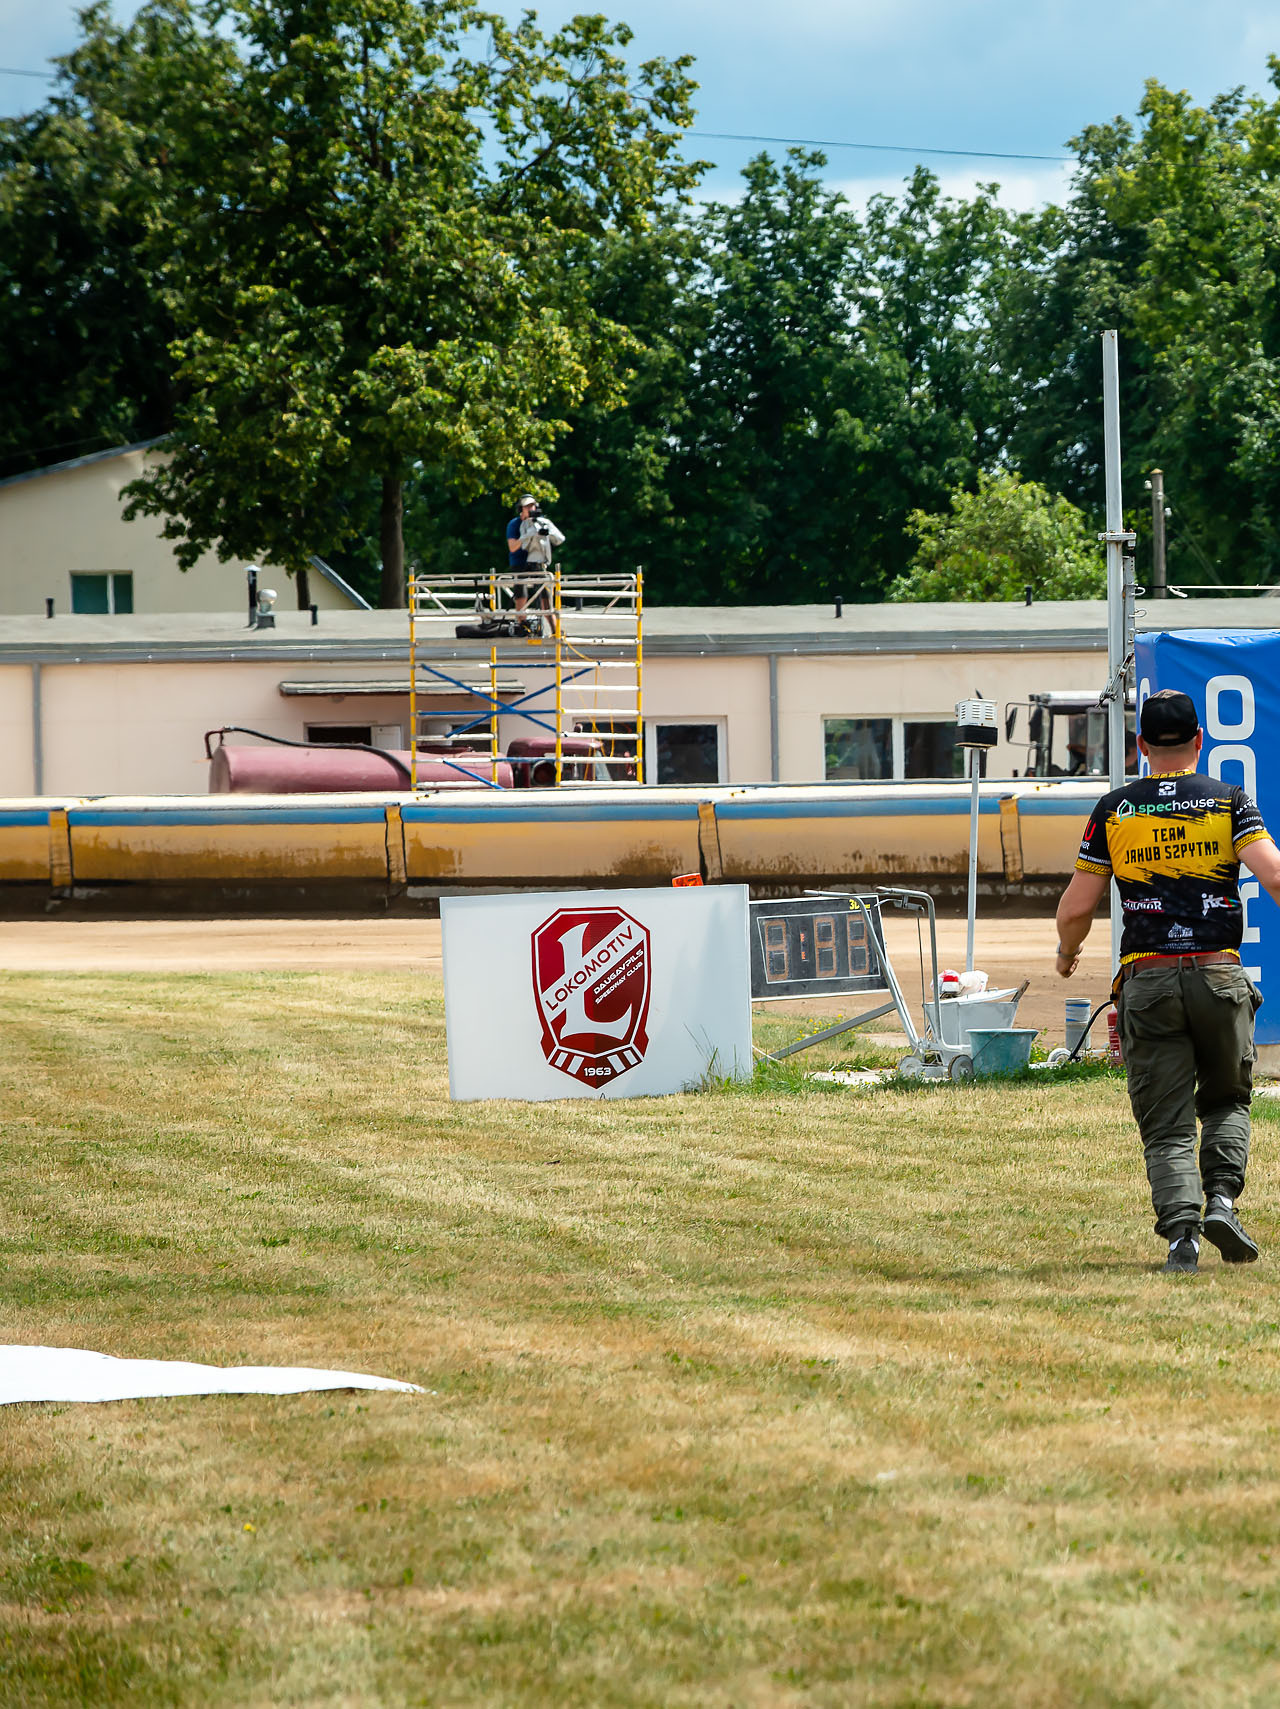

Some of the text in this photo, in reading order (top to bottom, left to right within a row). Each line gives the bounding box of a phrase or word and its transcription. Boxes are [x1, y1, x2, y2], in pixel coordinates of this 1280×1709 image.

[1152, 825, 1185, 842] TEAM
[545, 925, 632, 1011] LOKOMOTIV
[593, 948, 644, 994] DAUGAVPILS
[595, 961, 644, 1005] SPEEDWAY CLUB
[584, 1067, 612, 1076] 1963
